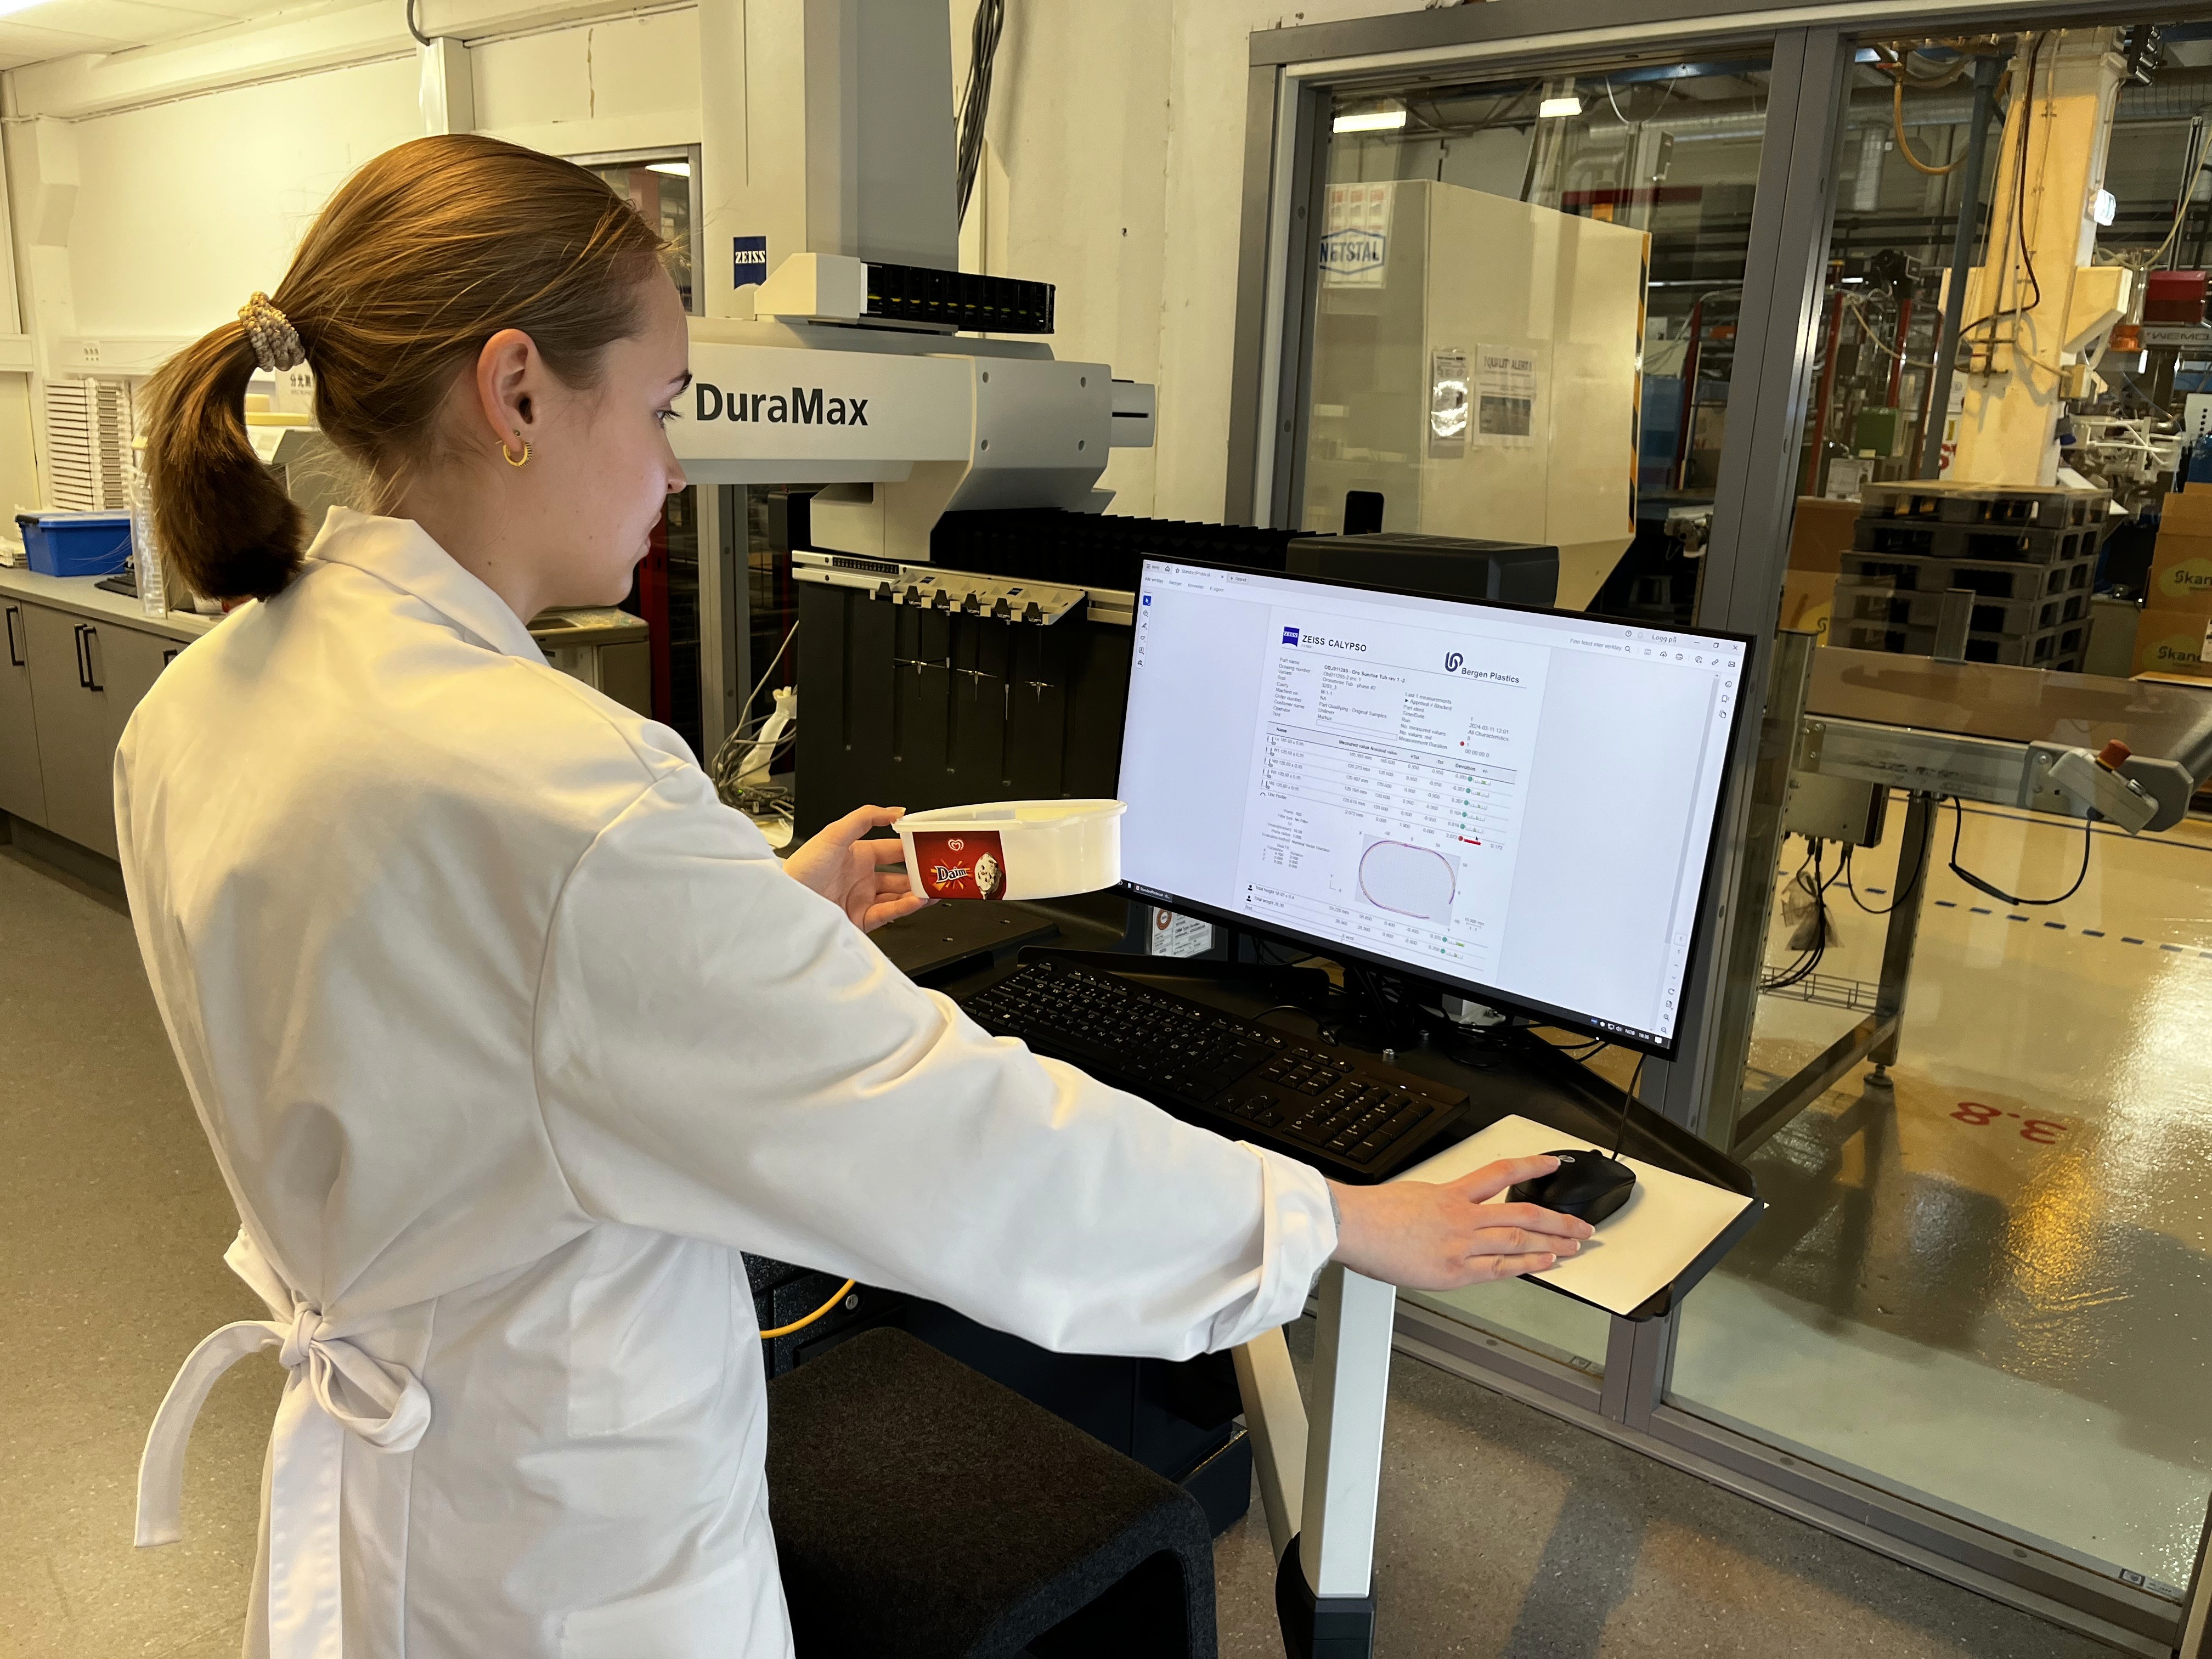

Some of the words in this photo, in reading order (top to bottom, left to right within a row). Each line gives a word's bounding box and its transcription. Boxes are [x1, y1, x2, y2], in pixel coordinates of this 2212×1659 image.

[1320, 241, 1379, 263] NETSTAL
[735, 251, 765, 264] ZEISS
[696, 383, 868, 426] DuraMax
[1302, 635, 1325, 645] ZEISS
[1328, 639, 1367, 652] CALYPSO
[1651, 634, 1667, 642] Logg
[1668, 635, 1677, 644] på
[1461, 667, 1488, 680] Bergen
[1489, 672, 1520, 683] Plastics
[1409, 699, 1429, 707] Approval
[1419, 695, 1452, 704] measurements
[1328, 703, 1348, 712] Qualifying
[1351, 708, 1368, 716] Original
[1368, 711, 1387, 719] Samples
[1402, 710, 1424, 719] Time/Date
[1408, 725, 1431, 733] measured
[1469, 723, 1494, 732] 2024-03-11
[1398, 736, 1428, 746] Measurement
[1475, 731, 1509, 741] Characteristics
[1455, 763, 1476, 771] Deviation
[935, 866, 968, 882] Daim
